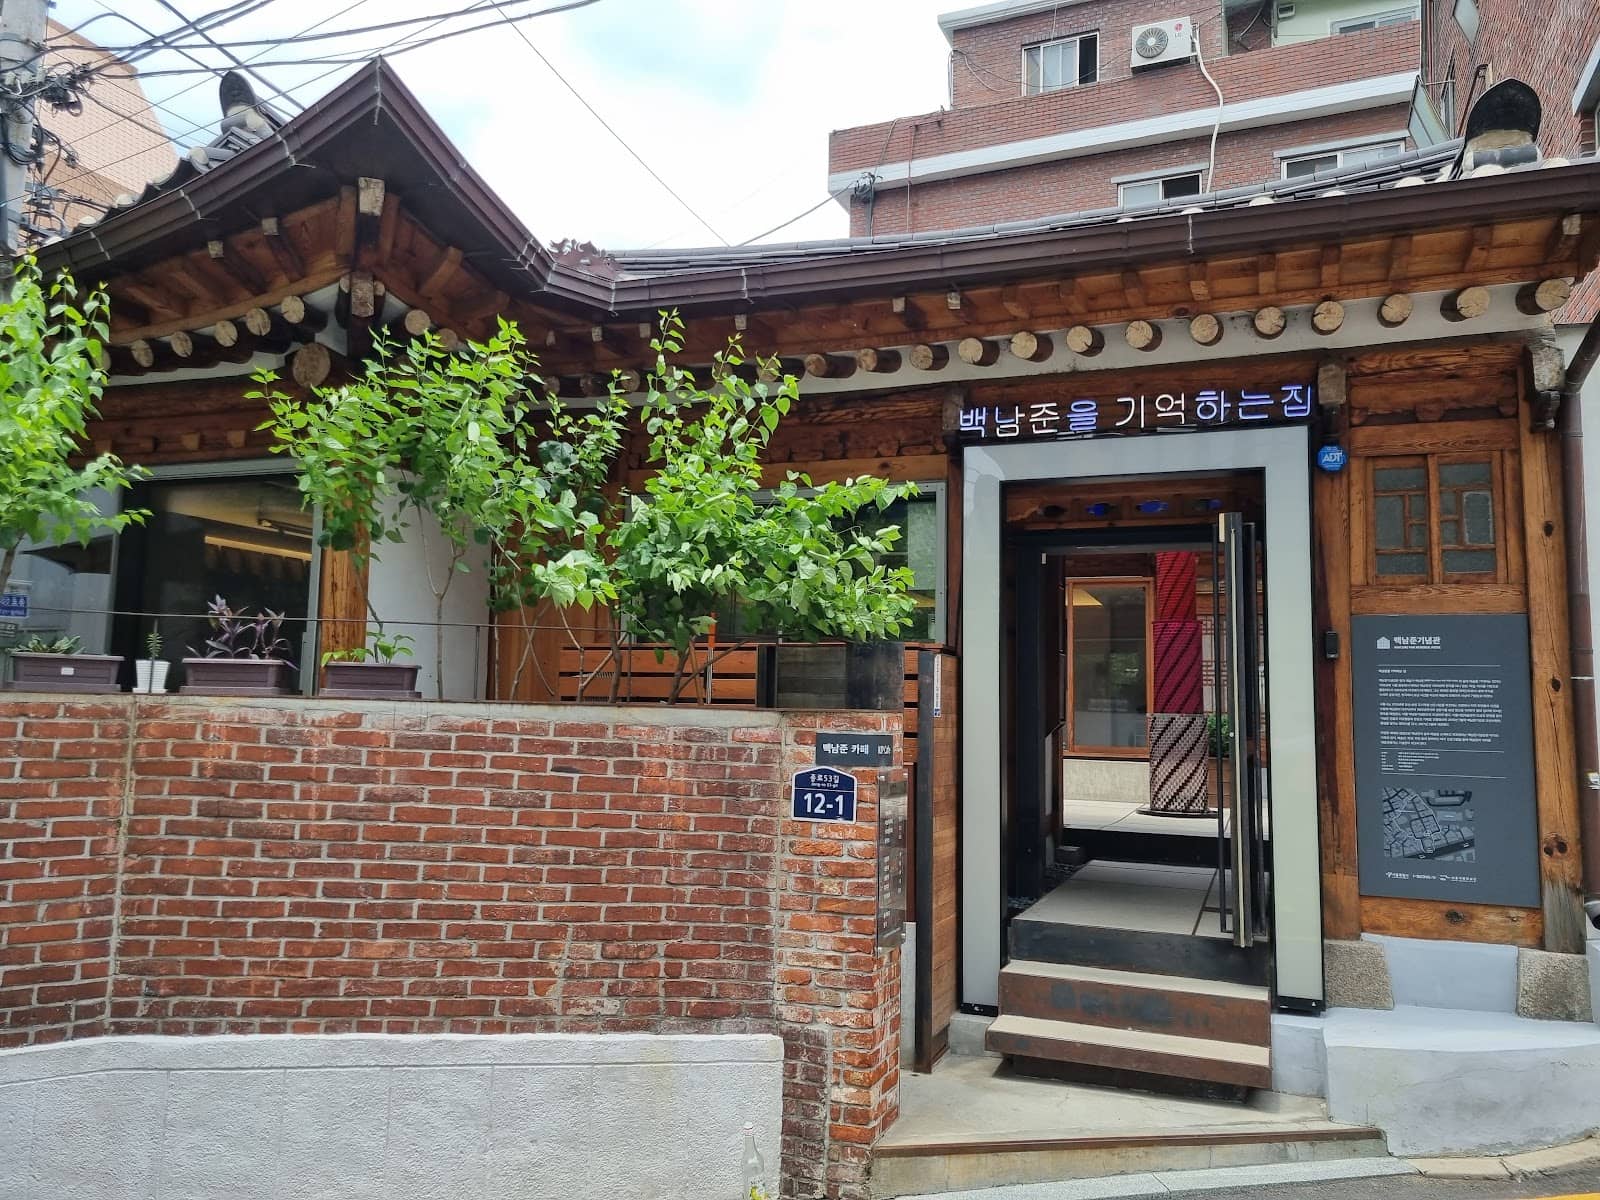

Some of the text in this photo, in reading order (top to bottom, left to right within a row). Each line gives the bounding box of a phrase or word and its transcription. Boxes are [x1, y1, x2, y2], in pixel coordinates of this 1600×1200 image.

[958, 399, 1099, 437] 백남준을
[1322, 452, 1342, 463] ADT
[822, 743, 848, 754] 백남준
[850, 743, 869, 755] 카페
[803, 793, 844, 815] 12-1
